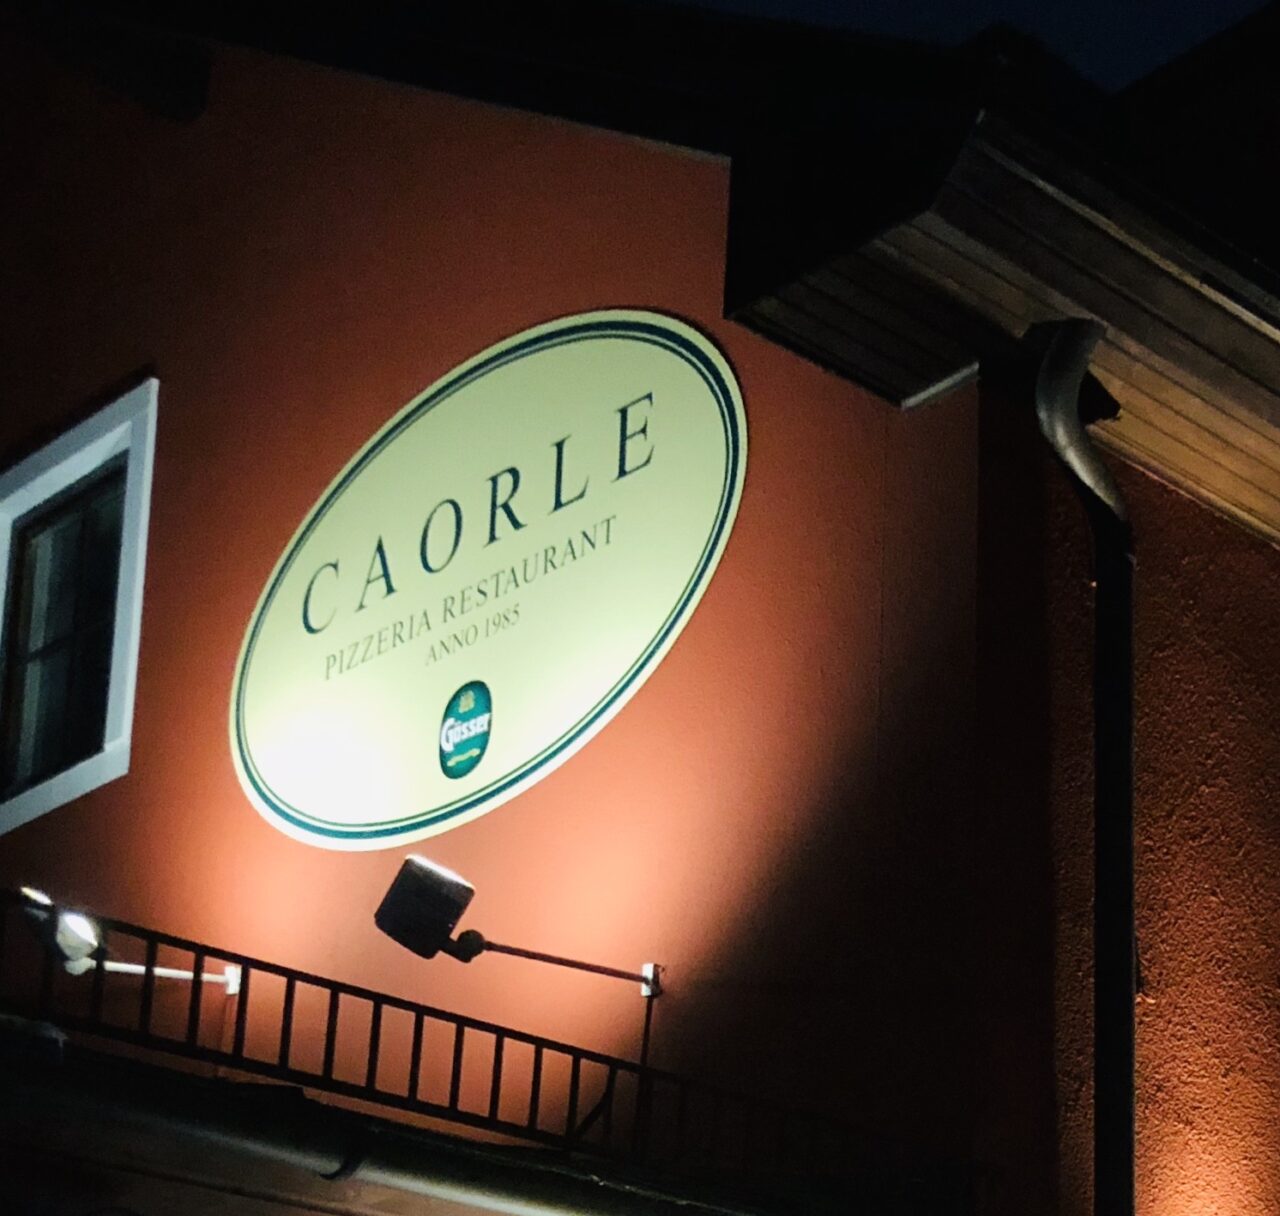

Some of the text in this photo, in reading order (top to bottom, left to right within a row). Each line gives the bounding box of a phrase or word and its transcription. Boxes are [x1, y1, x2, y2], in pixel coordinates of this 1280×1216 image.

[301, 391, 656, 635] CAORLE
[325, 515, 617, 681] PIZZERIA RESTAURANT
[424, 603, 520, 666] ANNO 1985
